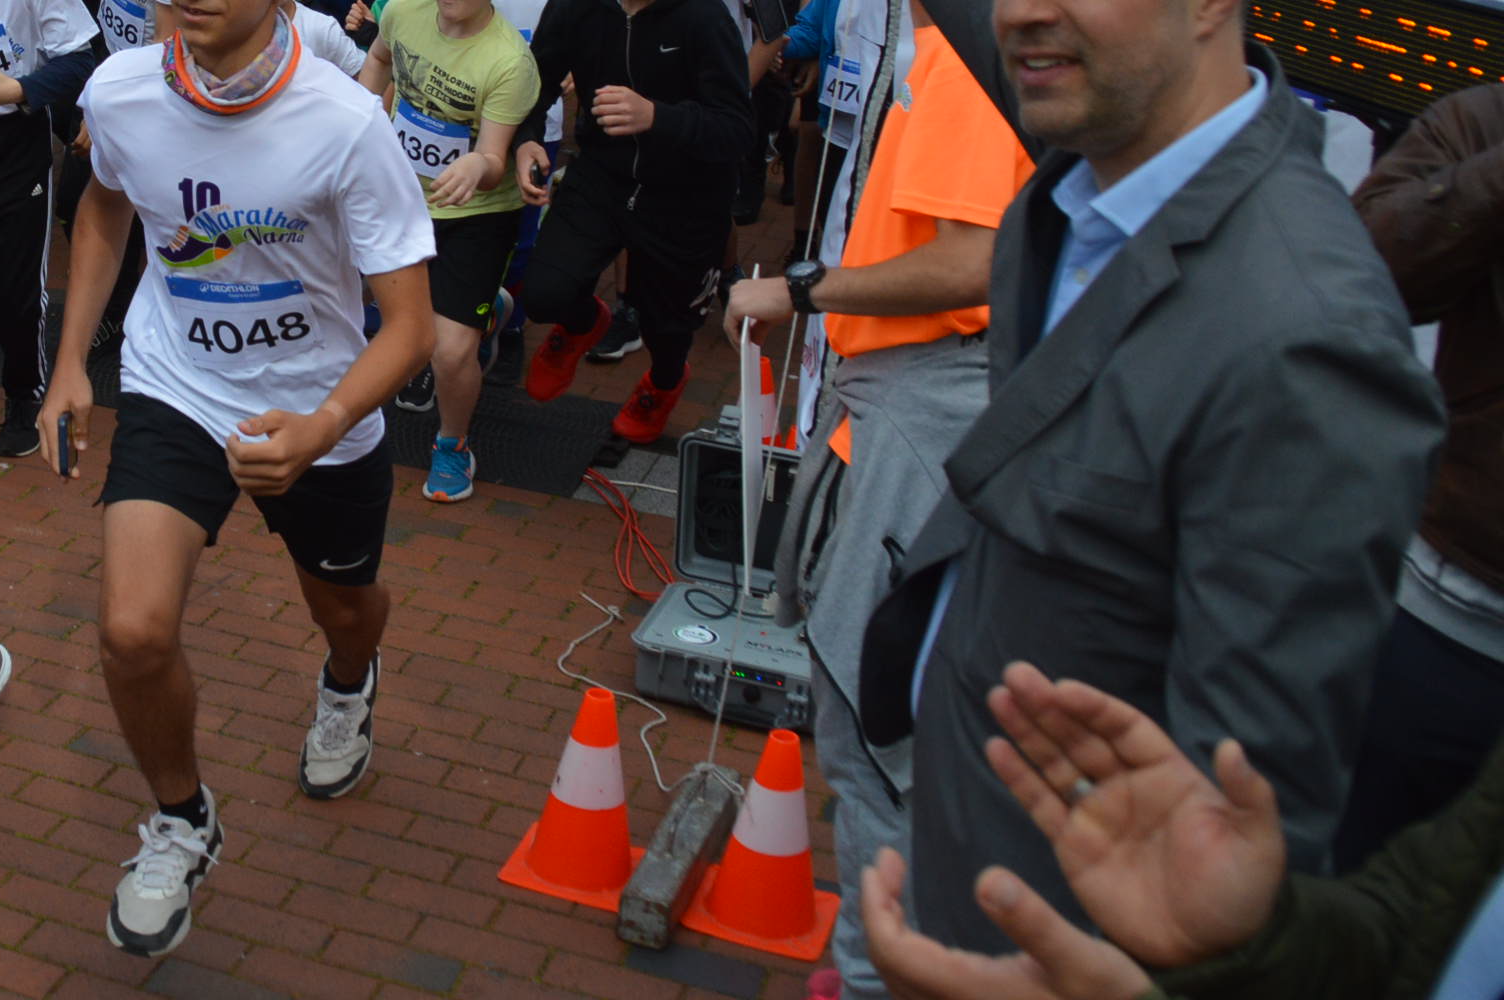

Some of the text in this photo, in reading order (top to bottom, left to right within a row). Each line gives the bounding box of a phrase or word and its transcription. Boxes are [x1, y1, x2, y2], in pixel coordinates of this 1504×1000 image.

[430, 74, 443, 89] THE
[433, 65, 477, 94] EXPLORING
[178, 178, 221, 224] 10
[194, 207, 309, 241] Marathon
[244, 227, 304, 246] Varna
[188, 311, 311, 355] 4048
